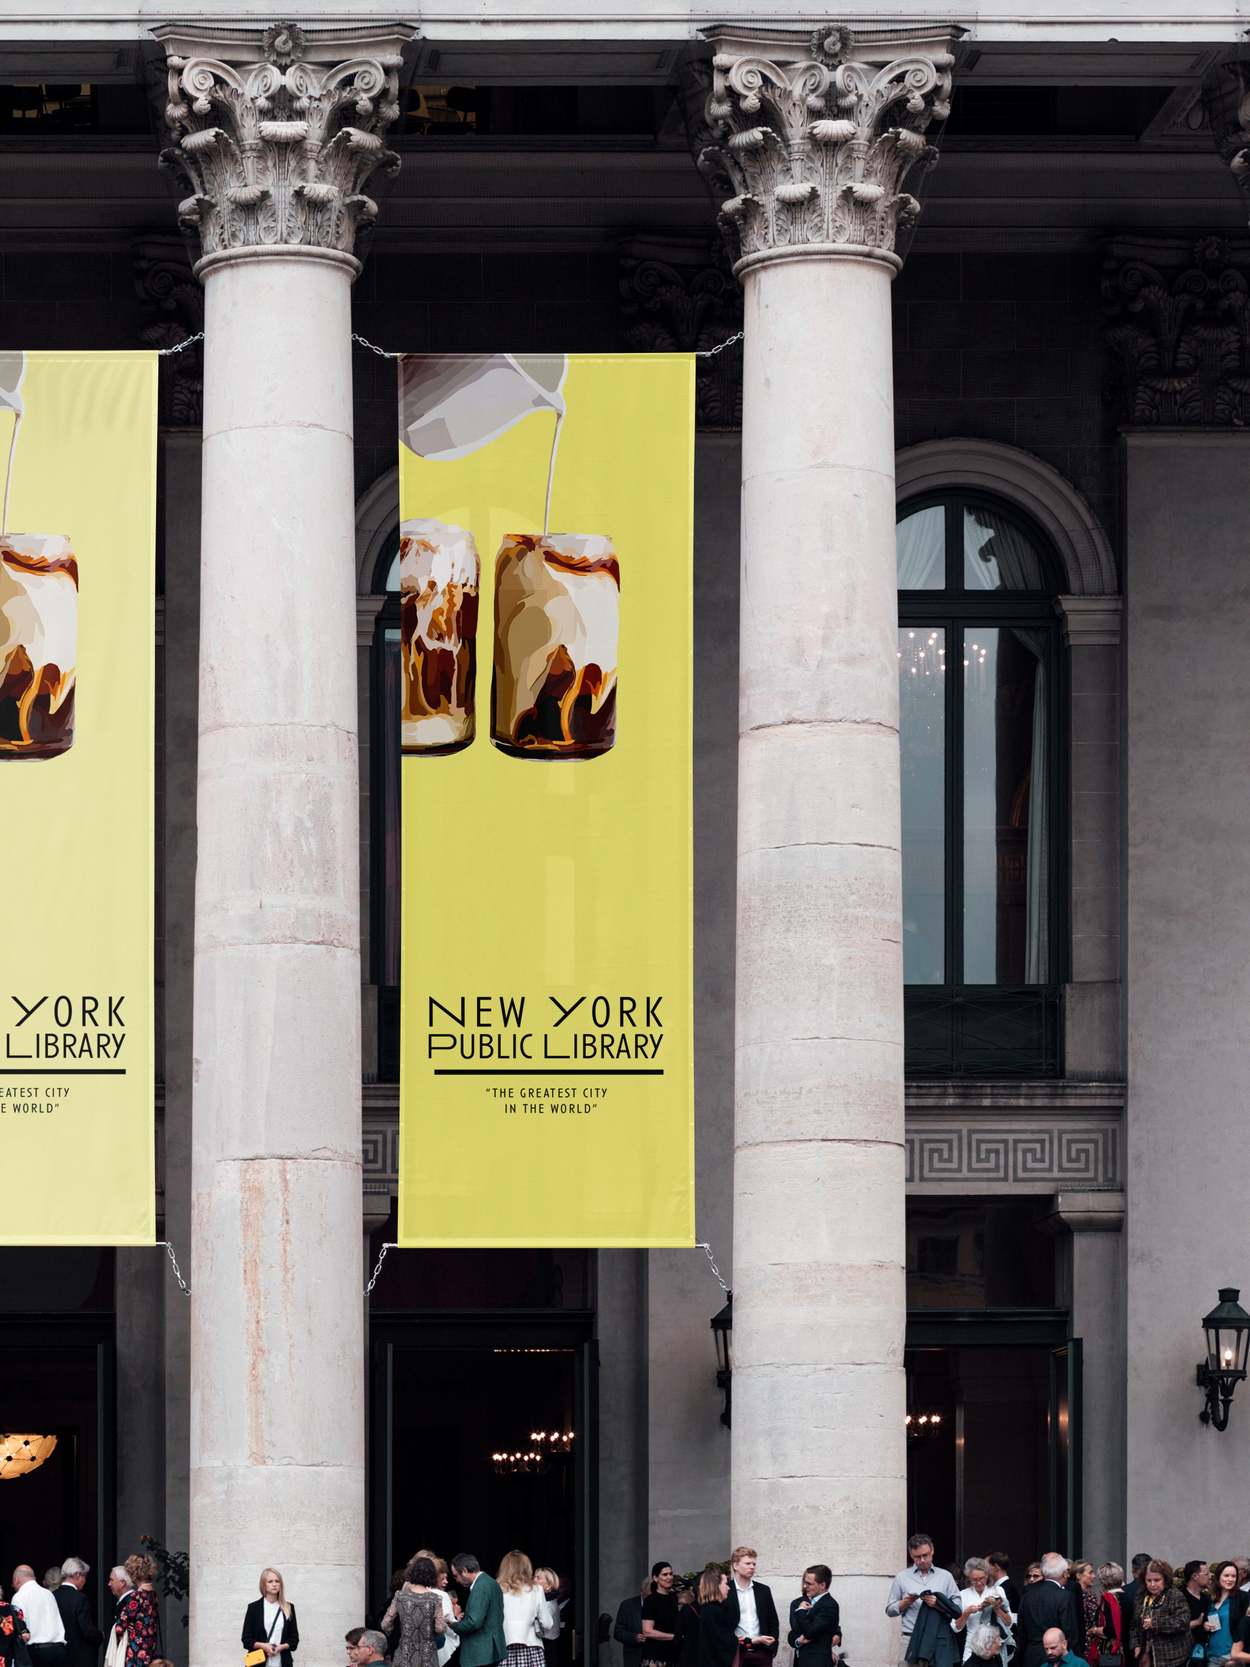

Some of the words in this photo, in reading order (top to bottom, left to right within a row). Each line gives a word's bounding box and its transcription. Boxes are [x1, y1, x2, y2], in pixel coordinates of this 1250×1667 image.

[11, 995, 126, 1028] YORK
[428, 995, 526, 1028] NEW
[548, 995, 663, 1029] YORK
[6, 1032, 126, 1059] LIBRARY
[428, 1033, 533, 1060] PUBLIC
[543, 1032, 664, 1060] LIBRARY
[45, 1087, 70, 1098] CITY
[519, 1087, 577, 1099] GREATEST
[582, 1087, 608, 1099] CITY
[504, 1103, 517, 1114] IN
[522, 1103, 545, 1114] THE
